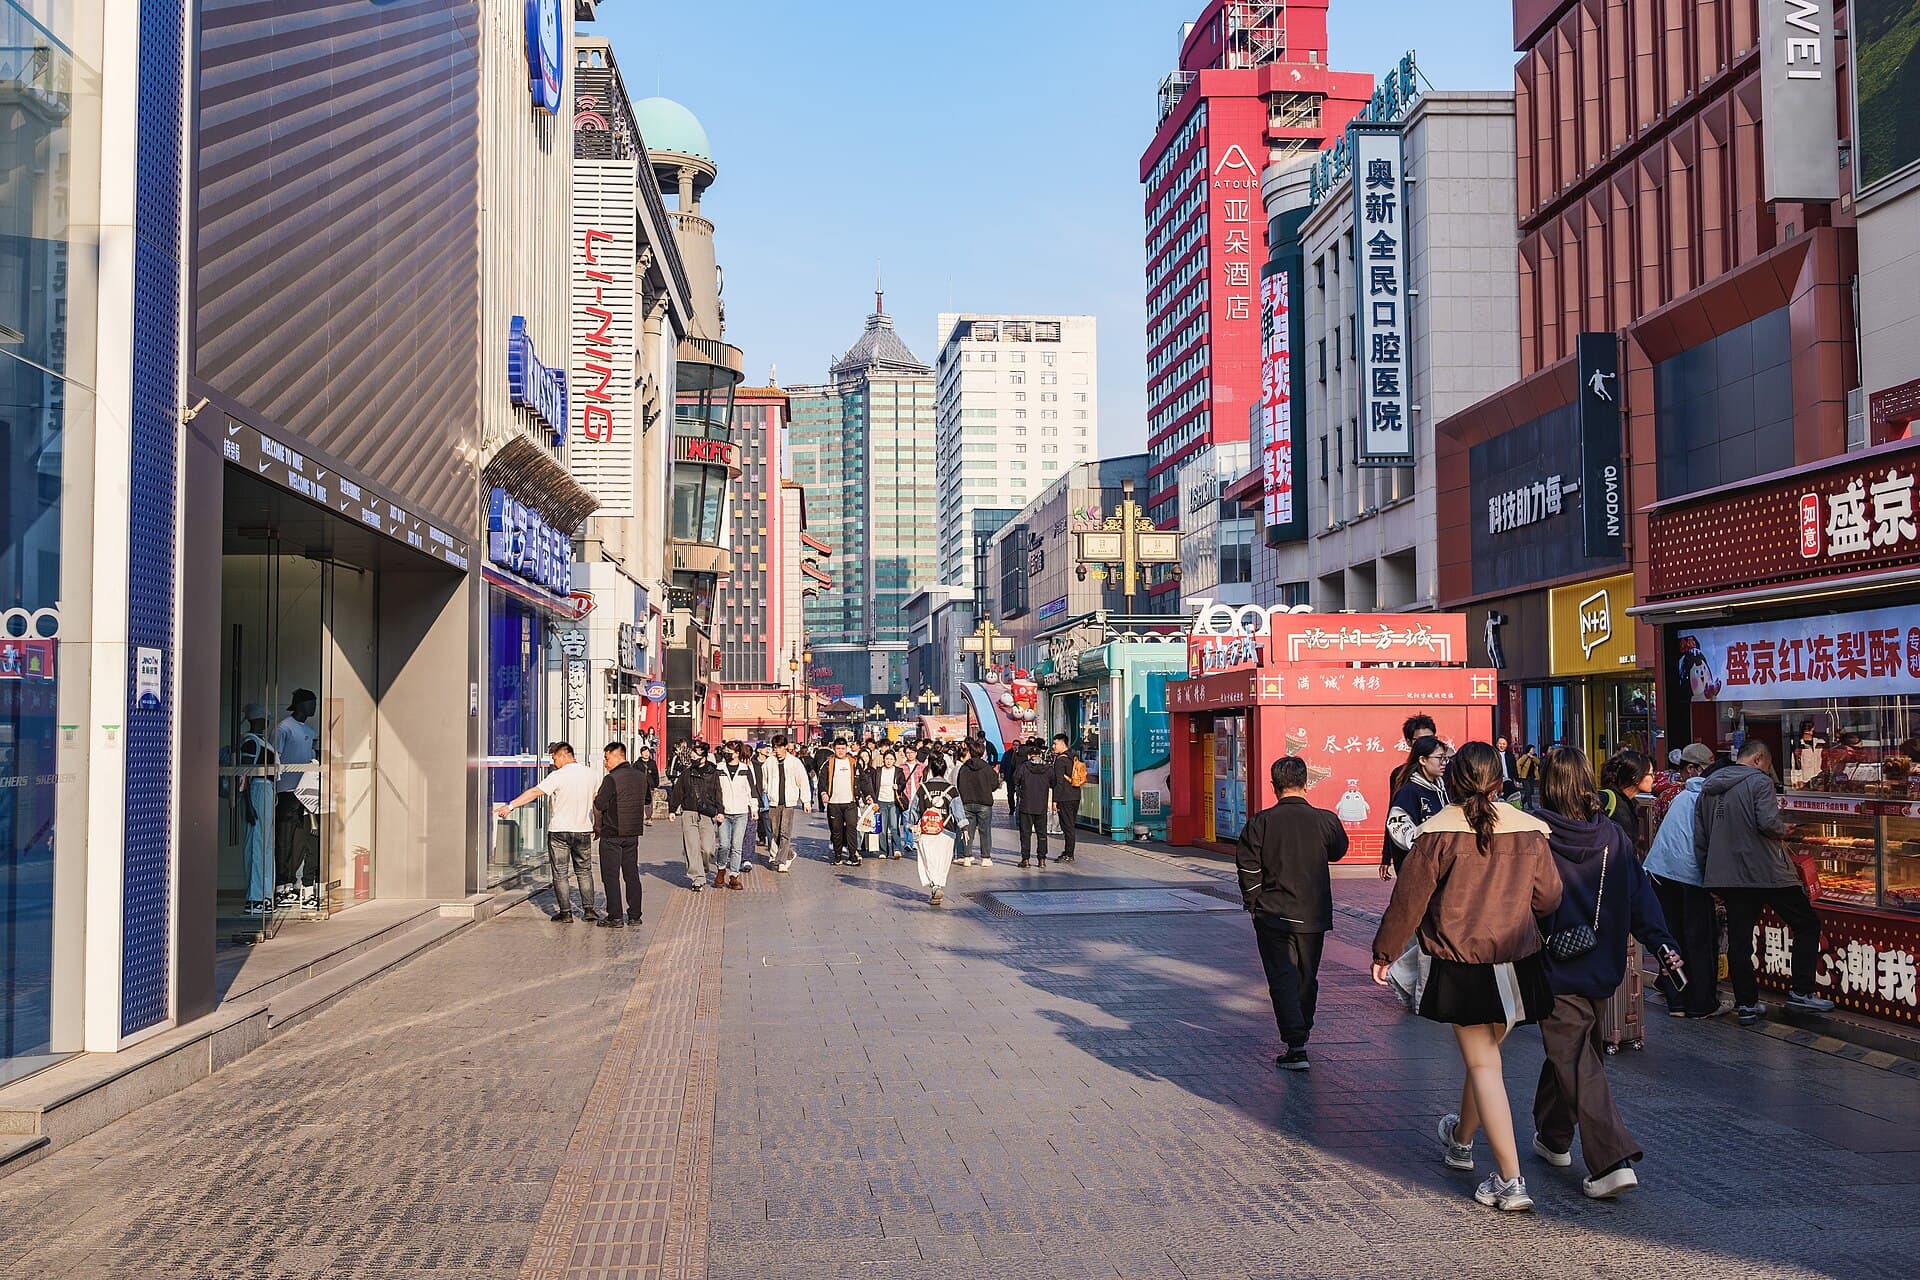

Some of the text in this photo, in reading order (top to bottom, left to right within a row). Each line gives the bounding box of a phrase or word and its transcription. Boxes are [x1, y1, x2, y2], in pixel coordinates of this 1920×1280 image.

[1213, 180, 1258, 188] ATOUR
[1224, 199, 1250, 320] 亚朵酒店
[1365, 158, 1402, 432] 奥新全民口腔医院
[584, 229, 614, 443] LI-NING
[687, 440, 732, 464] KFC
[1488, 474, 1582, 534] 科技助力每一
[1604, 465, 1620, 536] QIAODAN
[1803, 504, 1817, 548] 如意
[1825, 469, 1917, 557] 盛京
[1304, 622, 1436, 652] 沈阳方城
[1726, 628, 1903, 686] 盛京红冻梨酥
